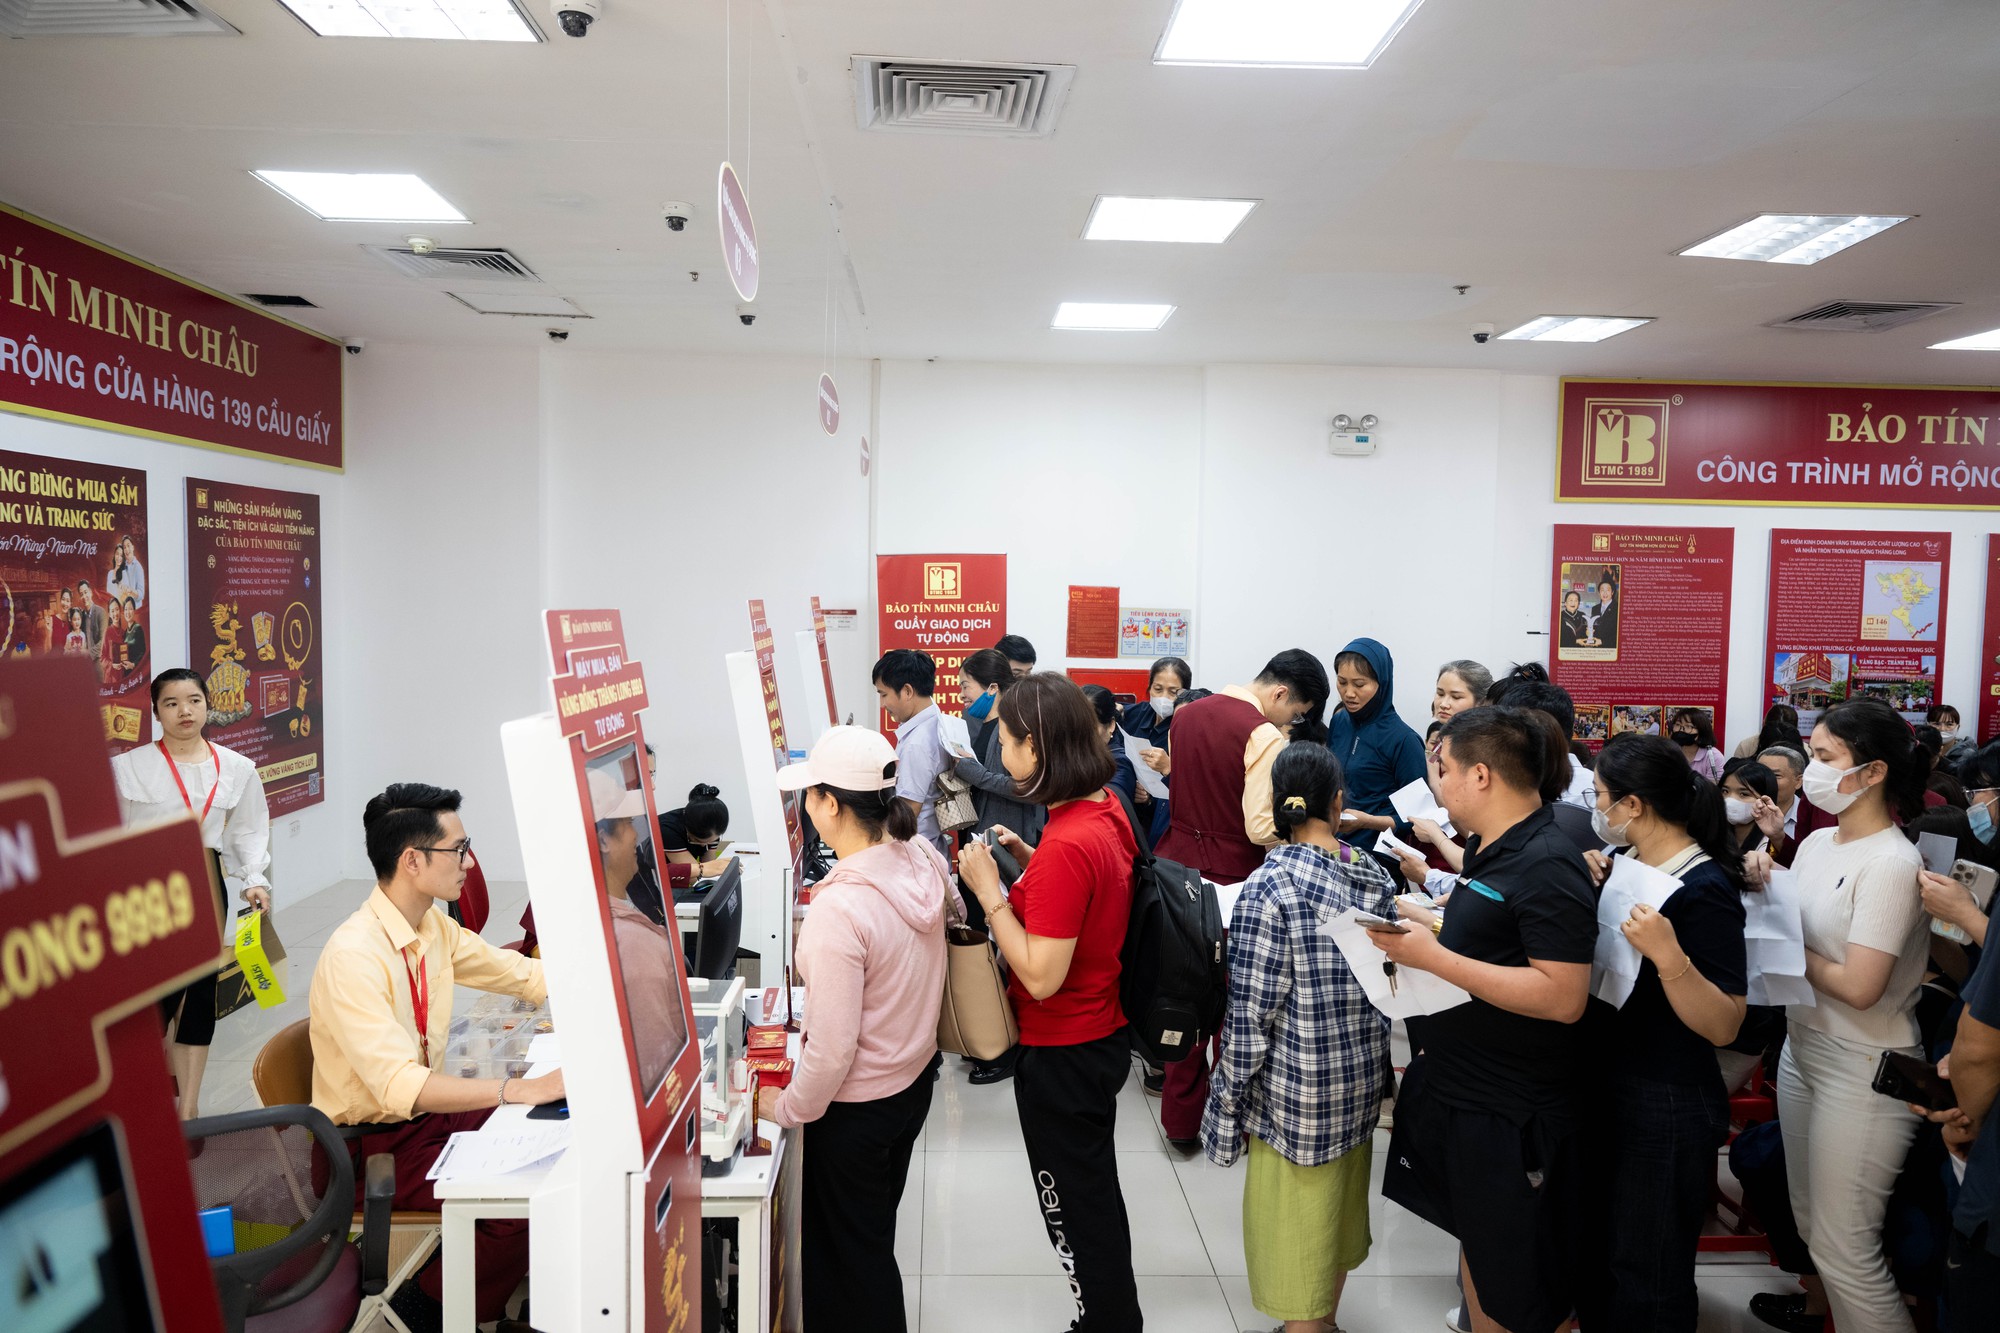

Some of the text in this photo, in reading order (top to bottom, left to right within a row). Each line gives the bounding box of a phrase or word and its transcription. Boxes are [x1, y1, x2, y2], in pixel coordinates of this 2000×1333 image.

[68, 278, 172, 351] MINH
[179, 319, 259, 377] CHÂU
[0, 334, 331, 446] RỘNG CỬA HÀNG 139 CẦU GIẤY
[1826, 402, 1989, 446] BẢO TÍN
[1594, 464, 1655, 477] BTMC 1989
[1697, 454, 1778, 485] CÔNG
[1785, 456, 1870, 486] TRÌNH
[1879, 456, 1923, 487] MỞ
[0, 464, 138, 506] NG BỪNG MUA SẮM
[0, 501, 115, 531] NG VÀ TRANG SỨC
[213, 498, 302, 520] NHỮNG SẢN PHẨM VÀNG
[198, 515, 214, 531] ĐẶC
[215, 514, 231, 531] SẮC,
[232, 519, 247, 533] TIỆN
[247, 518, 259, 531] ÍCH
[260, 522, 268, 533] VÀ
[269, 521, 284, 534] GIÀU
[1632, 533, 1644, 542] TÍN
[1664, 534, 1684, 543] CHÂU
[10, 535, 46, 559] Mừng
[46, 537, 77, 557] Năm
[215, 533, 302, 551] CỦA BẢO TÍN MINH CHÂU
[886, 601, 1000, 613] BẢO TÍN MINH CHÂU
[894, 615, 991, 631] QUẦY GIAO DỊCH
[916, 631, 969, 645] TỰ ĐỘNG
[575, 651, 622, 679] MÁY MUA, BÁN
[595, 710, 626, 739] TỰ ĐỘNG
[0, 904, 104, 1008] ONG
[1037, 1170, 1062, 1226] neo
